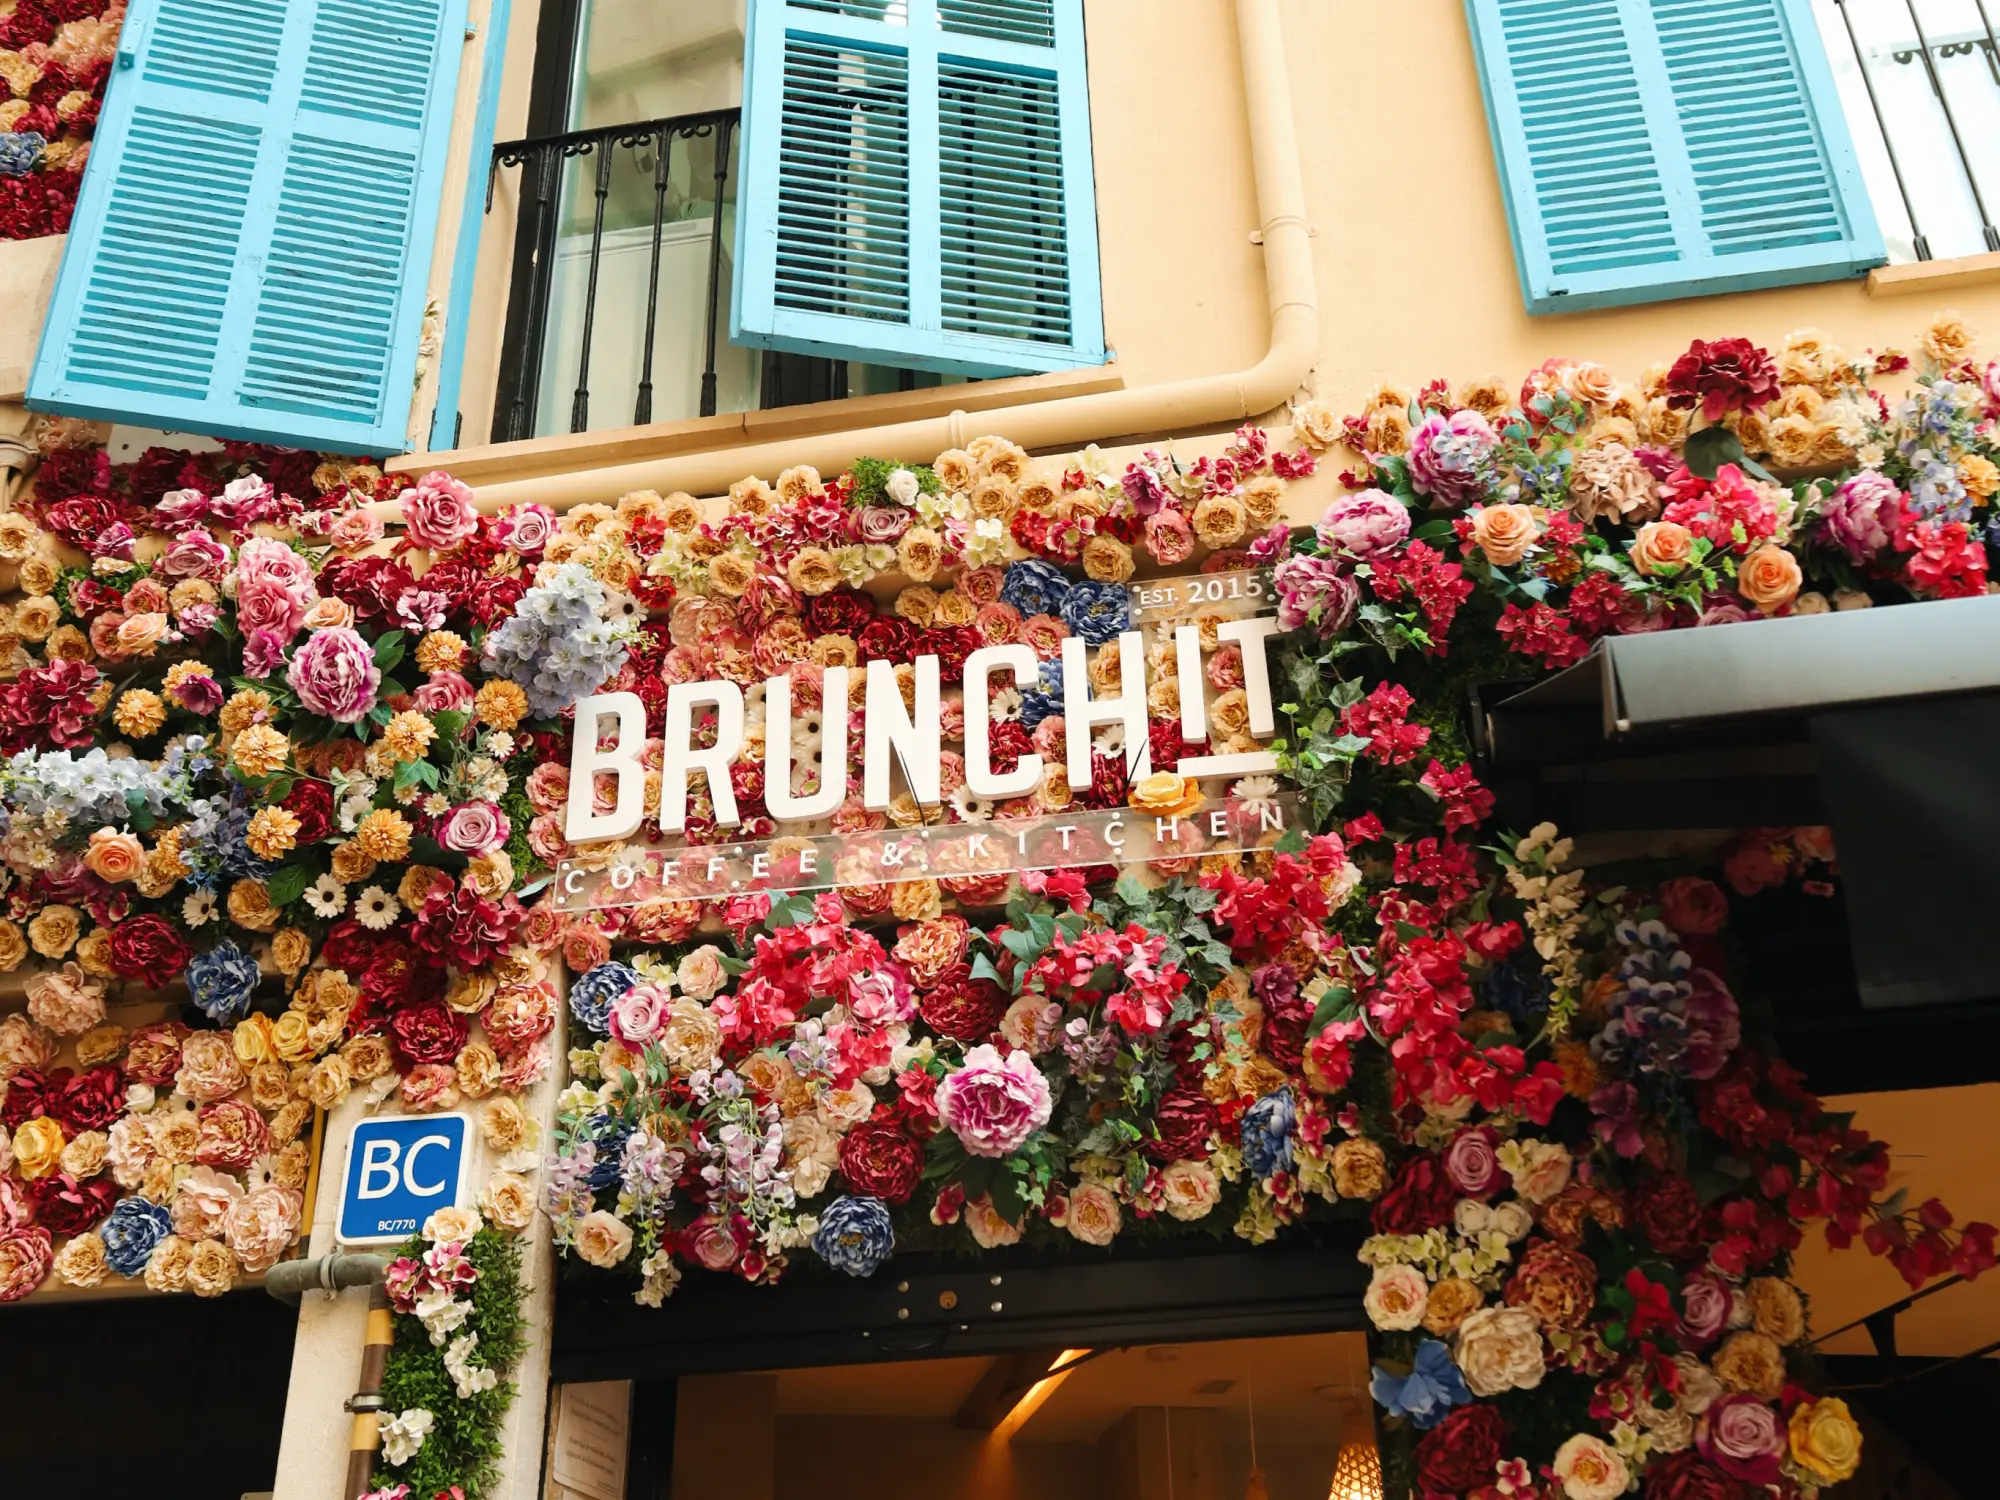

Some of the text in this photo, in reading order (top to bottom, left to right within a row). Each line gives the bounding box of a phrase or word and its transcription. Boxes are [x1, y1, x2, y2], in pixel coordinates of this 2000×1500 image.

[1140, 575, 1263, 607] EST. 2015
[564, 804, 1285, 894] COFFEE & KITCHEN
[357, 1135, 451, 1200] BC
[377, 1218, 416, 1232] BC/770
